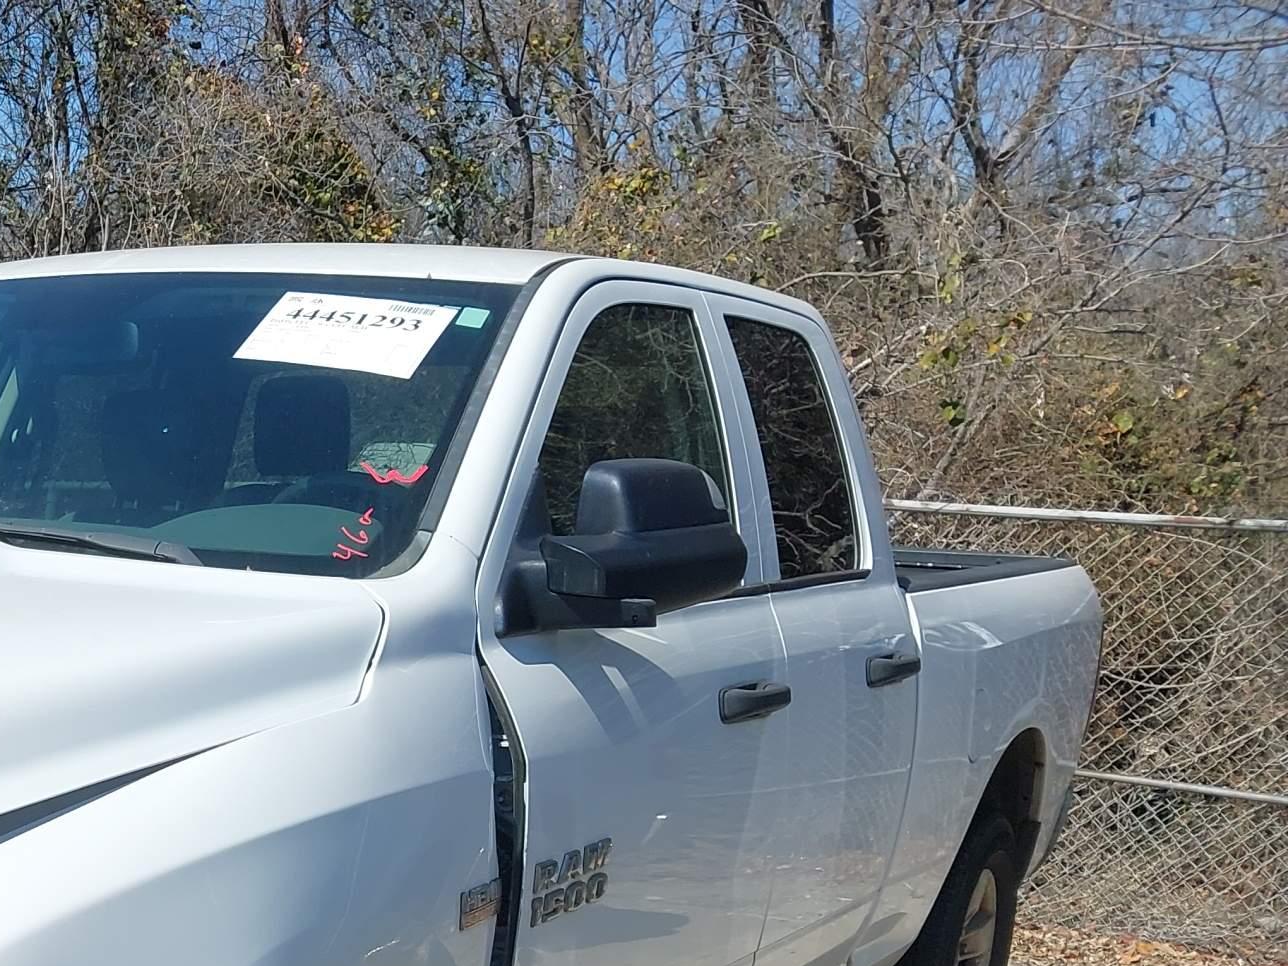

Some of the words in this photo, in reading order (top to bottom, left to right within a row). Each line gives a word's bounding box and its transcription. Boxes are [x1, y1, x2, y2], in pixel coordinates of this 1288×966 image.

[286, 308, 423, 332] 44451293
[533, 837, 613, 894] RAM
[530, 872, 608, 928] 1500
